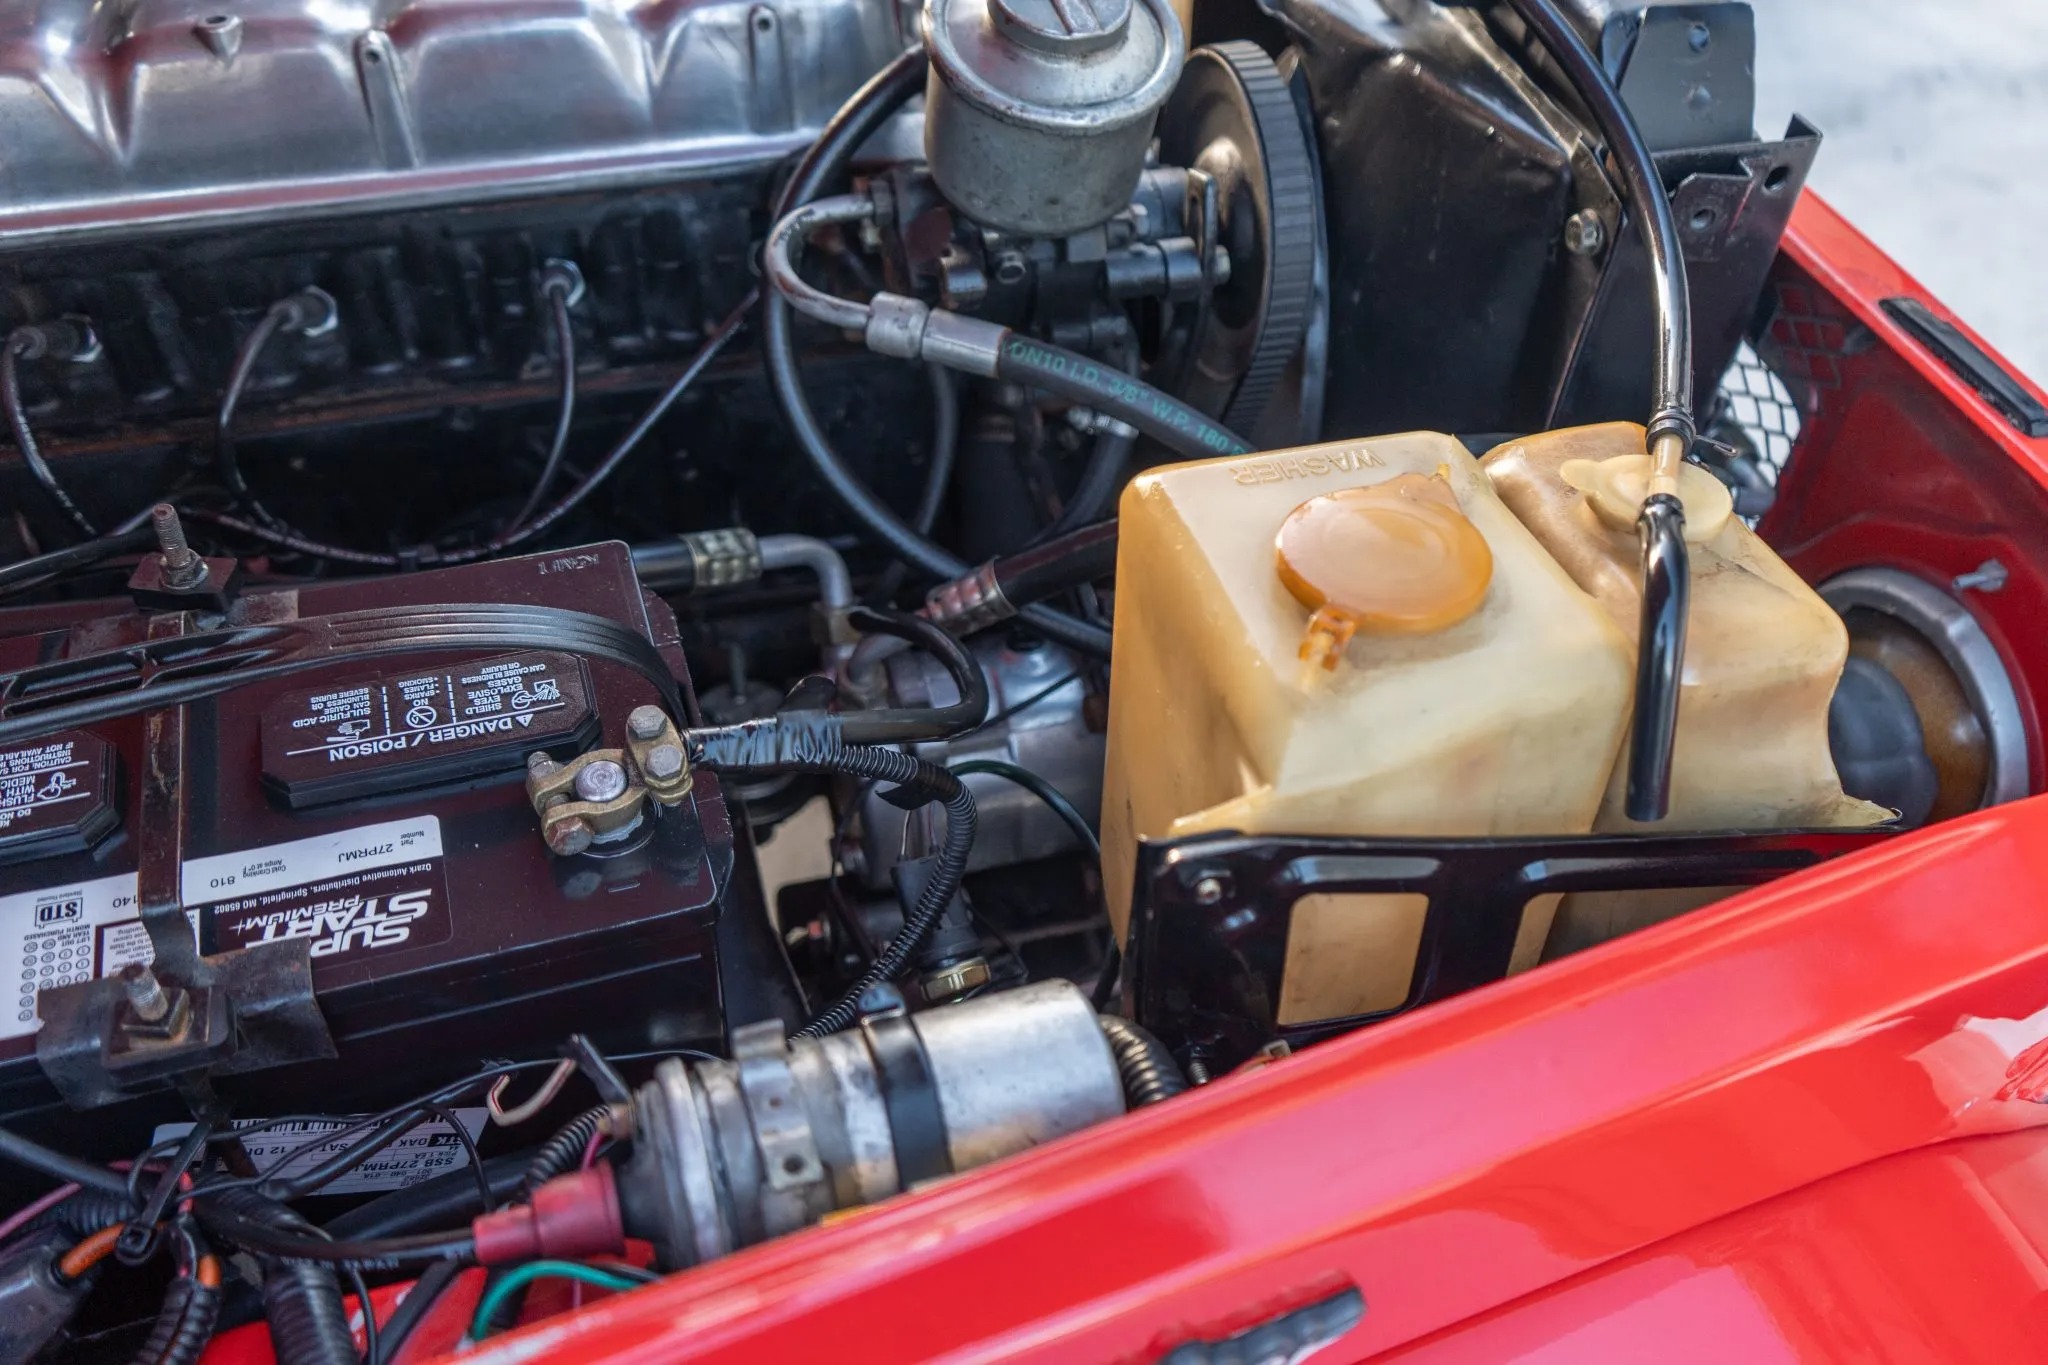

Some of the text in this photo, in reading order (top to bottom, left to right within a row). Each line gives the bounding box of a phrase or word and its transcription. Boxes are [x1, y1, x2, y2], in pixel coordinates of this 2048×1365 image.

[1198, 424, 1229, 452] 180
[1229, 448, 1384, 486] WASHER
[462, 663, 546, 683] CAN CAUSE BLINDNESS
[481, 662, 520, 674] OR INJURY
[398, 677, 433, 688] SMOKING
[404, 683, 434, 693] FLAMES
[487, 676, 522, 688] GASES
[310, 688, 368, 703] SEVERE BURNS
[404, 690, 435, 700] SPARKS
[468, 683, 523, 699] EXPLOSIVE
[312, 694, 369, 710] BLINDNESS OR
[413, 698, 428, 706] NO
[474, 695, 500, 705] EYES
[324, 700, 370, 714] CAN CAUSE
[466, 703, 502, 714] SHIELD
[292, 708, 370, 727] SULFURIC ACID
[429, 717, 512, 742] DANGER
[46, 744, 63, 752] NOT
[329, 736, 406, 762] POISON
[10, 750, 70, 766] INSTRUCTIONS
[12, 764, 29, 772] FOR
[6, 785, 34, 796] WITH
[17, 808, 31, 817] DO
[400, 830, 424, 840] Number
[338, 844, 393, 863] 27PRMJ
[264, 858, 282, 867] Amps
[243, 864, 286, 878] Cold Cranking
[210, 876, 236, 888] 810
[214, 863, 432, 914] Ozark Automotive Distributors, Springfield, MO 65802
[112, 895, 138, 908] 140
[40, 902, 77, 922] STD
[245, 888, 432, 948] START
[24, 924, 90, 940] MONTH PURCHASED
[72, 930, 90, 938] YEAR
[270, 1146, 286, 1154] 12
[321, 1143, 348, 1152] SAT
[354, 1158, 454, 1172] SSB 27PRMJ
